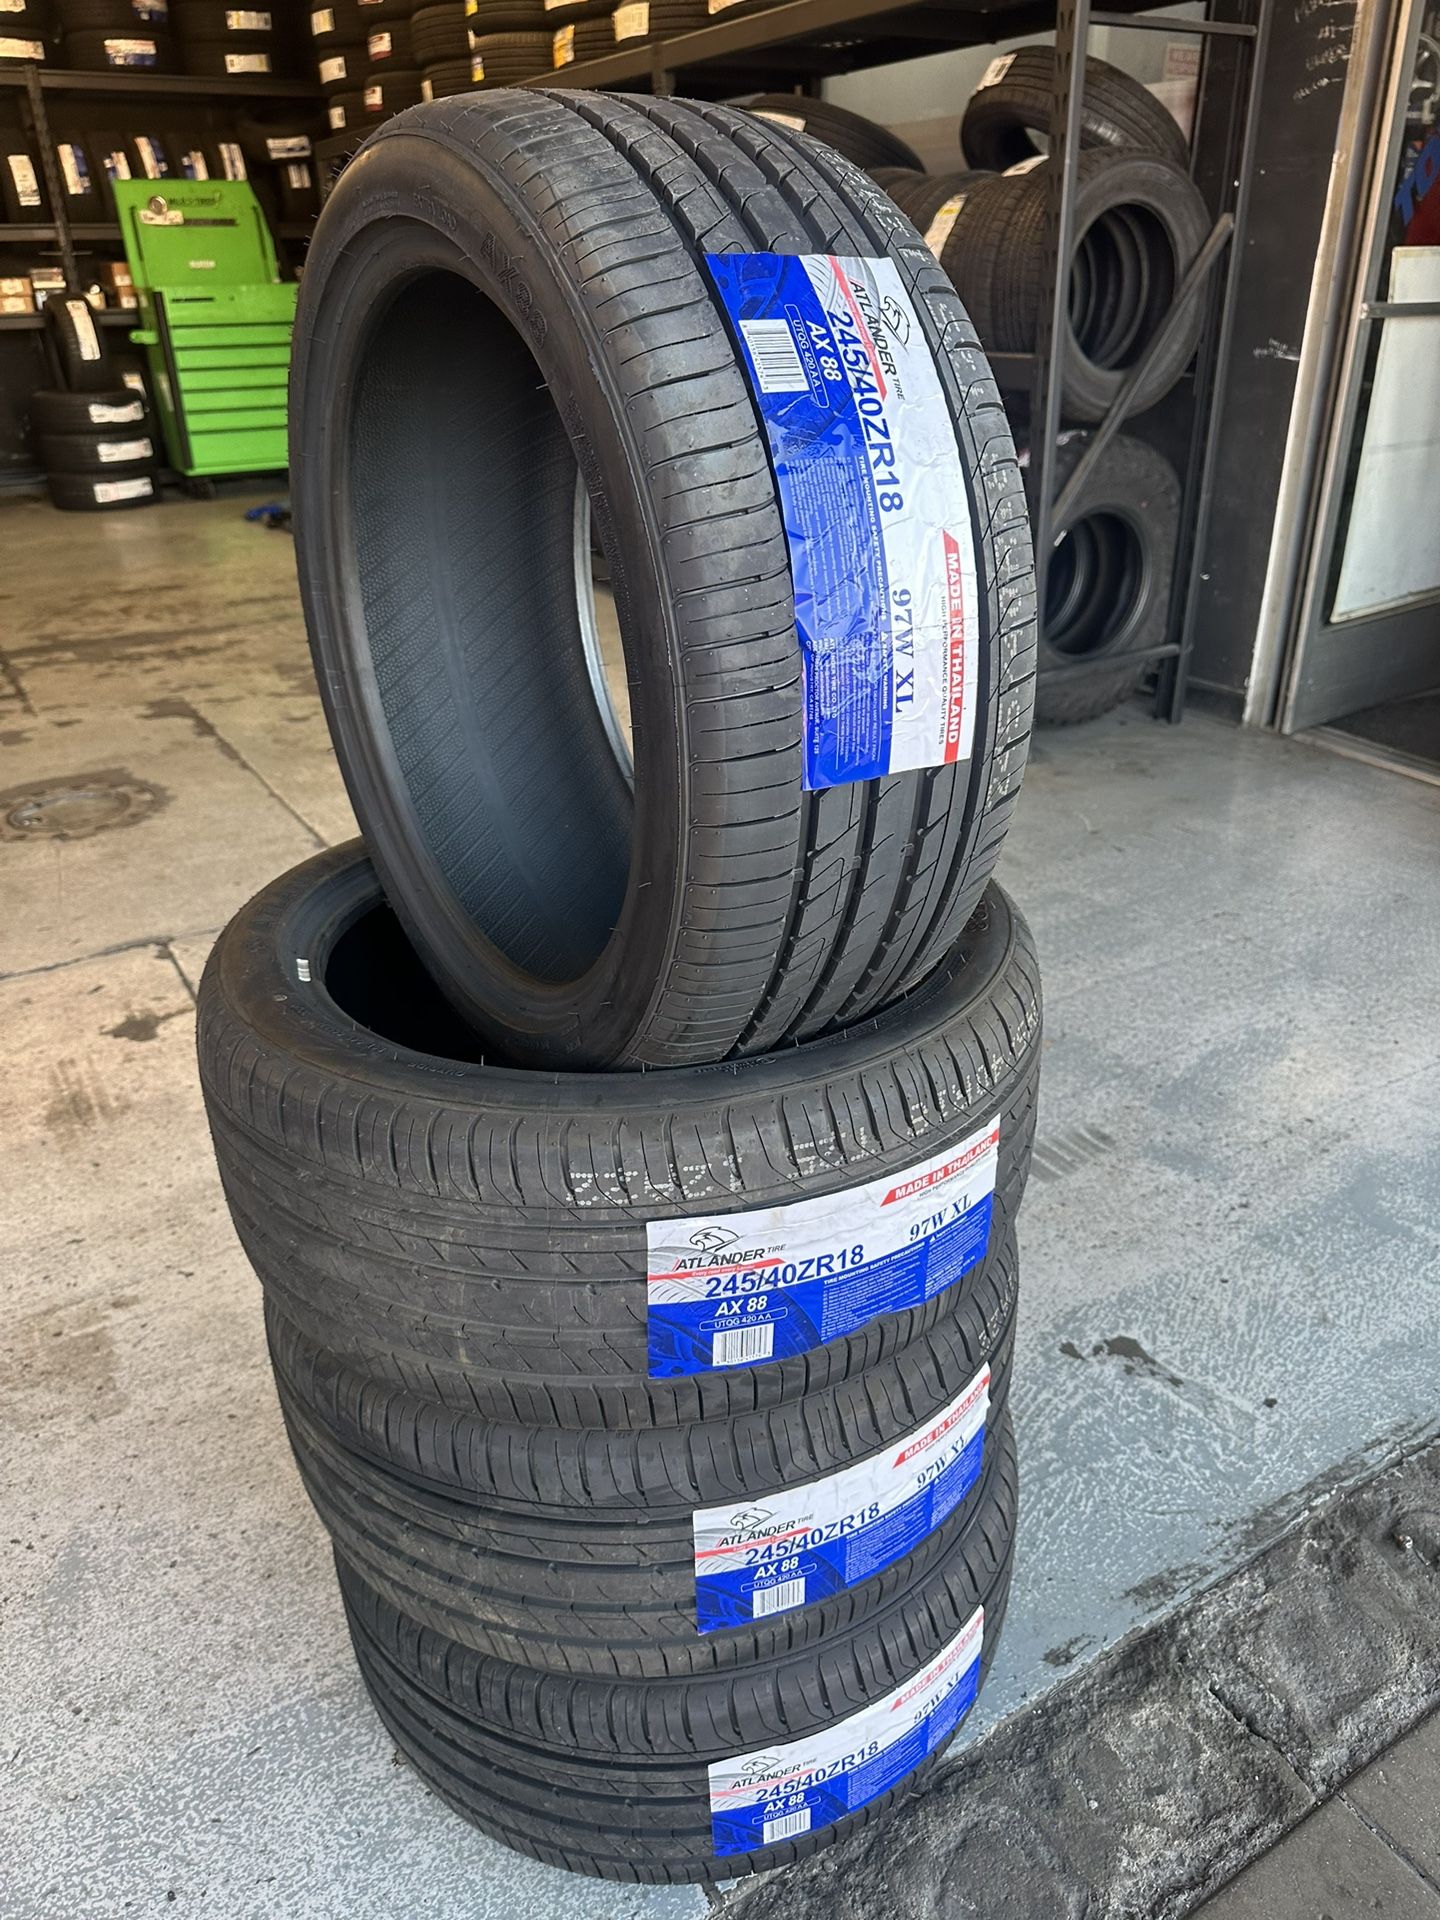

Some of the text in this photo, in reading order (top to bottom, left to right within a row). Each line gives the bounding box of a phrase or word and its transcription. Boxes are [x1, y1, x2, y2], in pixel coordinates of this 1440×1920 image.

[792, 319, 809, 349] UTQG
[804, 351, 816, 369] 420
[806, 320, 842, 381] AX 88
[849, 280, 897, 375] ATLANDER
[892, 378, 905, 401] TIRE
[826, 310, 904, 513] 245/40ZR18
[857, 455, 887, 621] TIRE MOUNTING SAFETY PRECAUTIONS
[893, 587, 915, 713] 97W XL
[941, 622, 949, 684] PERFORMANCE
[947, 553, 965, 744] MADE IN THAILAND
[940, 685, 948, 722] QUALITY
[938, 722, 946, 746] TIRES
[895, 1176, 929, 1199] MADE
[932, 1168, 946, 1182] IN
[947, 1137, 993, 1172] THAILAND
[909, 1207, 948, 1242] 97W
[951, 1193, 972, 1219] XL
[675, 1248, 765, 1271] ATLANDER
[767, 1244, 786, 1254] TIRE
[706, 1244, 864, 1298] 245/40ZR18
[823, 1276, 839, 1284] TIRE
[838, 1267, 870, 1281] MOUNTING
[869, 1258, 892, 1272] SAFETY
[714, 1317, 740, 1329] UTQG
[741, 1315, 757, 1323] 420
[715, 1295, 768, 1317] AX 88
[904, 1432, 934, 1459] MADE
[935, 1422, 946, 1436] IN
[718, 1520, 796, 1547] ATLANDER
[797, 1513, 814, 1524] TIRE
[745, 1502, 880, 1567] 245/40ZR18
[754, 1556, 799, 1580] AX 88
[731, 1763, 801, 1789] ATLANDER
[756, 1740, 880, 1803] 245/40ZR18
[764, 1792, 805, 1814] AX 88
